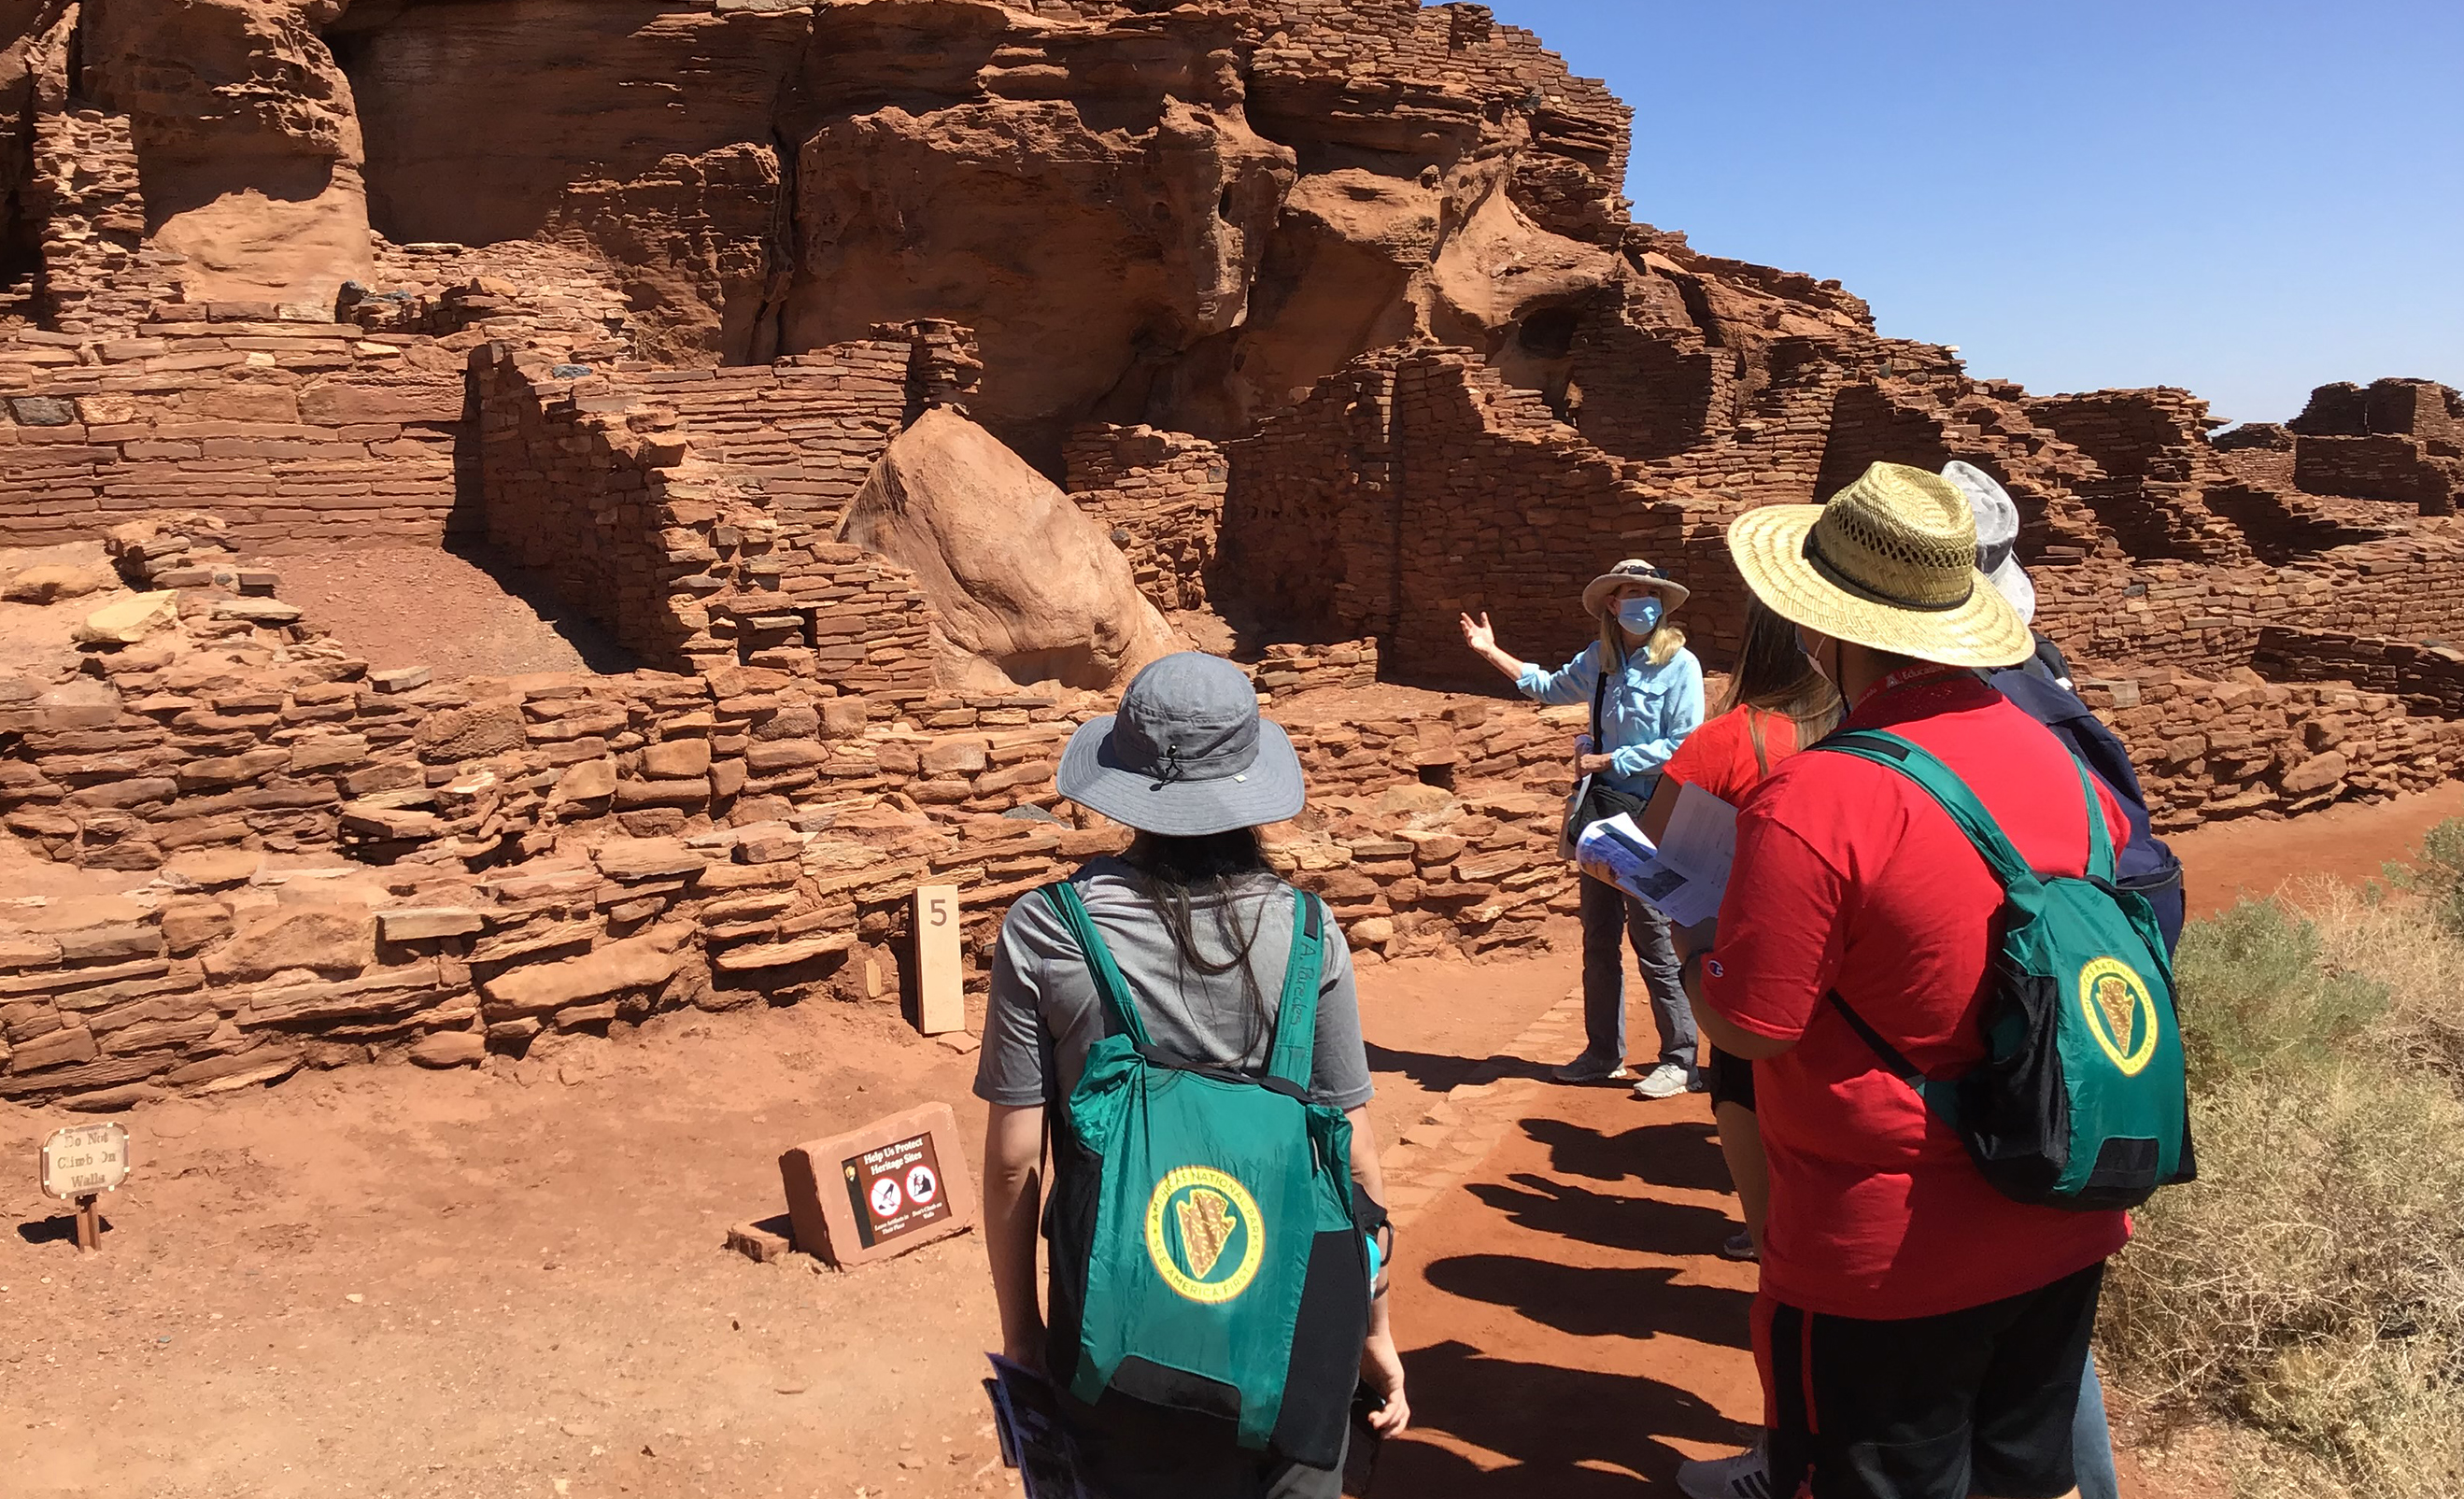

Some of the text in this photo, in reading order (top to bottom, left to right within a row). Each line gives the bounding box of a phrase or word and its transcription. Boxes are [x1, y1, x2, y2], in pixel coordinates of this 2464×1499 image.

[1902, 664, 1946, 681] Education
[930, 898, 947, 926] 5
[1290, 940, 1316, 1025] A. Paredes
[2138, 1035, 2154, 1063] FIRST
[64, 1131, 108, 1148] Do Not
[863, 1138, 924, 1166] Help Us Protect
[870, 1152, 923, 1176] Heritage Sites
[71, 1172, 106, 1188] Walls
[1191, 1172, 1249, 1206] NATIONAL
[1246, 1209, 1260, 1252] PARKS
[1153, 1239, 1252, 1296] SEE AMERICA FIRST
